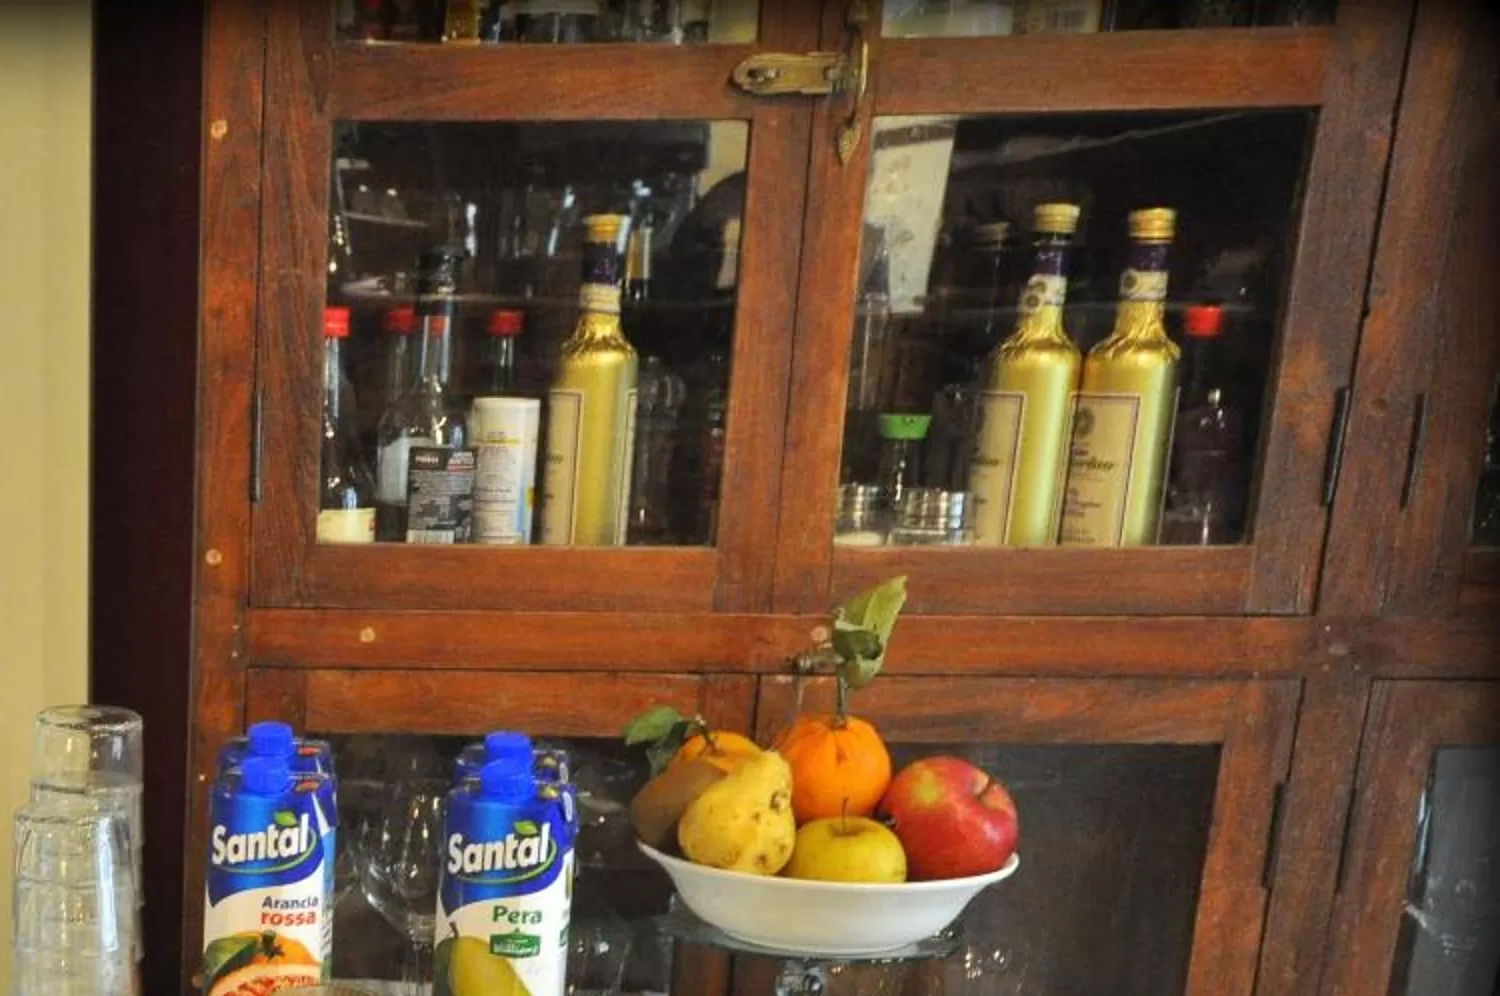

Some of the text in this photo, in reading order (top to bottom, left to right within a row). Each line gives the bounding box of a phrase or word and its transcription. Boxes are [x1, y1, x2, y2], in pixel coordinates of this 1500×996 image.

[211, 812, 310, 866] Santal
[447, 820, 551, 875] Santal
[261, 895, 320, 910] Arancia
[261, 911, 317, 926] rossa
[491, 905, 543, 925] Pera
